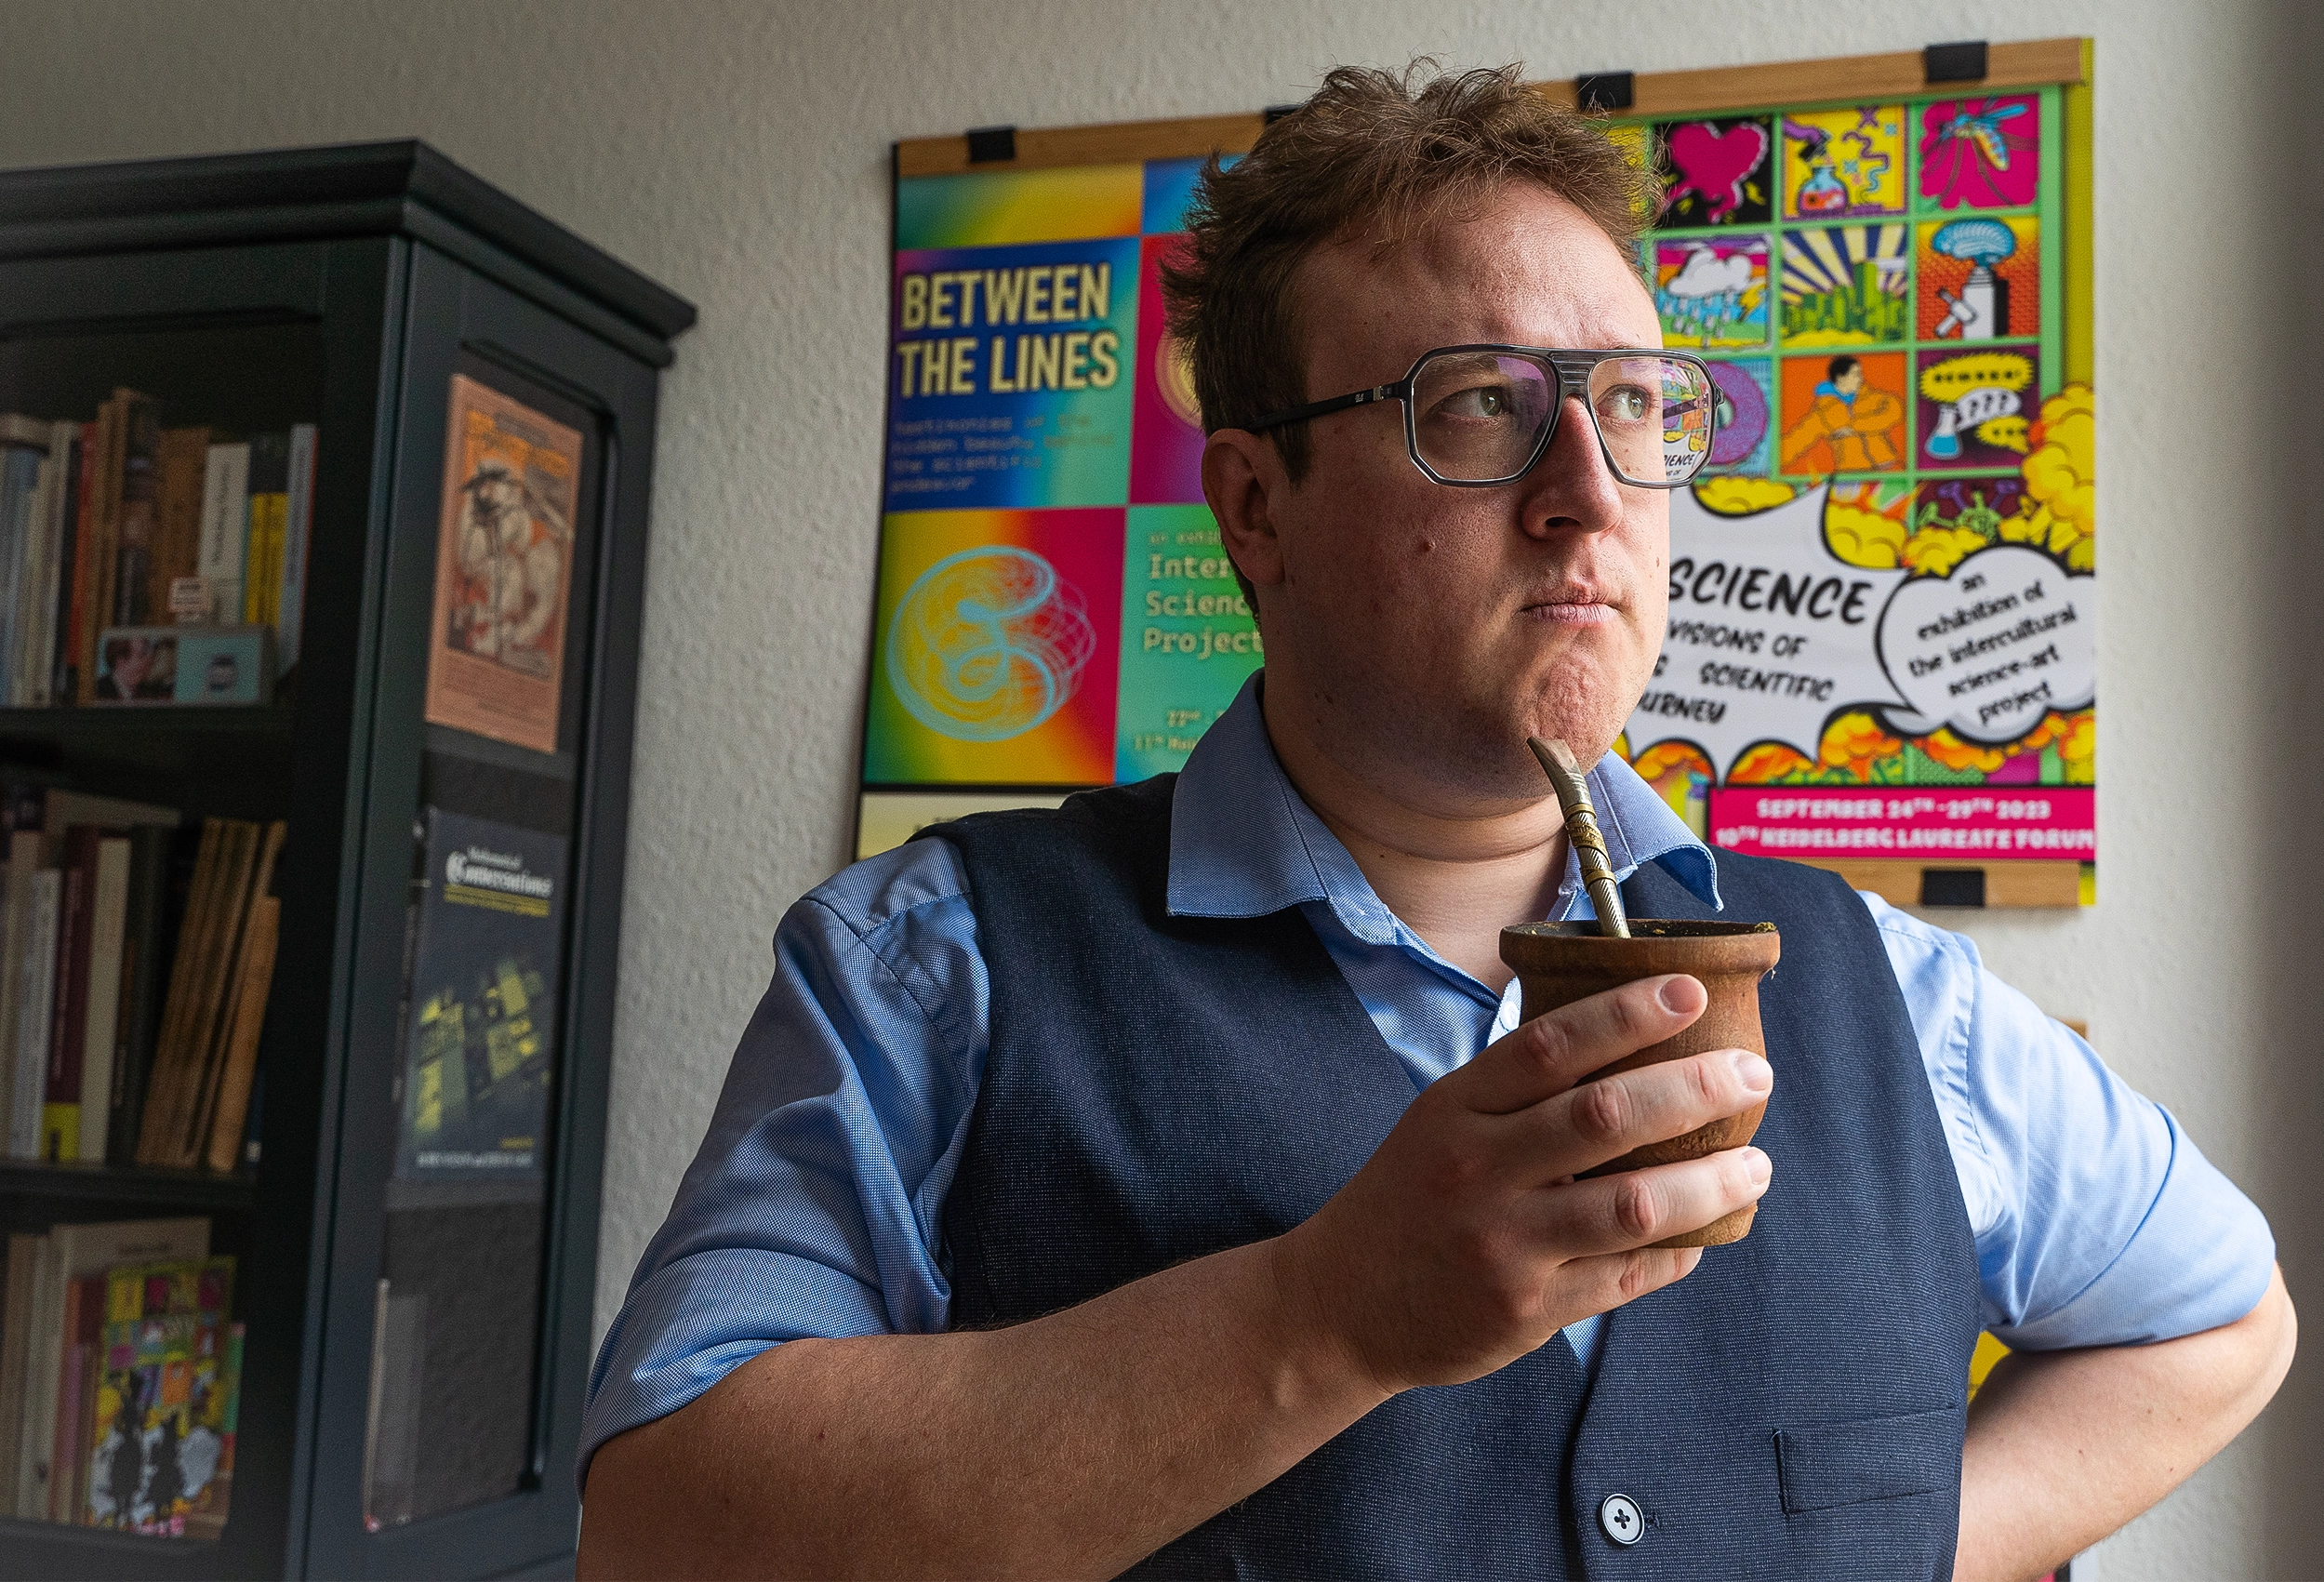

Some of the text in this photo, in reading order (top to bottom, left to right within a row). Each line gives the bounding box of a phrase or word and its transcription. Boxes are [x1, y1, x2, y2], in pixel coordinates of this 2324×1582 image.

[900, 262, 1111, 331] BETWEEN
[896, 330, 1119, 398] THE LINES
[1146, 590, 1253, 617] Scienc
[1668, 558, 1872, 624] SCIENCE
[1961, 573, 1987, 592] an
[1918, 578, 2045, 641] exhibition of
[1668, 619, 1807, 658] VISIONS OF
[1908, 602, 2078, 677] the intercultural
[1699, 661, 1835, 702] SCIENTIFIC
[1949, 643, 2061, 697] science-art
[1638, 691, 1727, 725] URNEY
[1979, 681, 2052, 727] project
[1757, 798, 1883, 819] SEPTEMBER
[1760, 827, 1894, 848] HEIDELBERG
[1895, 827, 2012, 849] LAUREATE
[2014, 828, 2093, 849] FORUM
